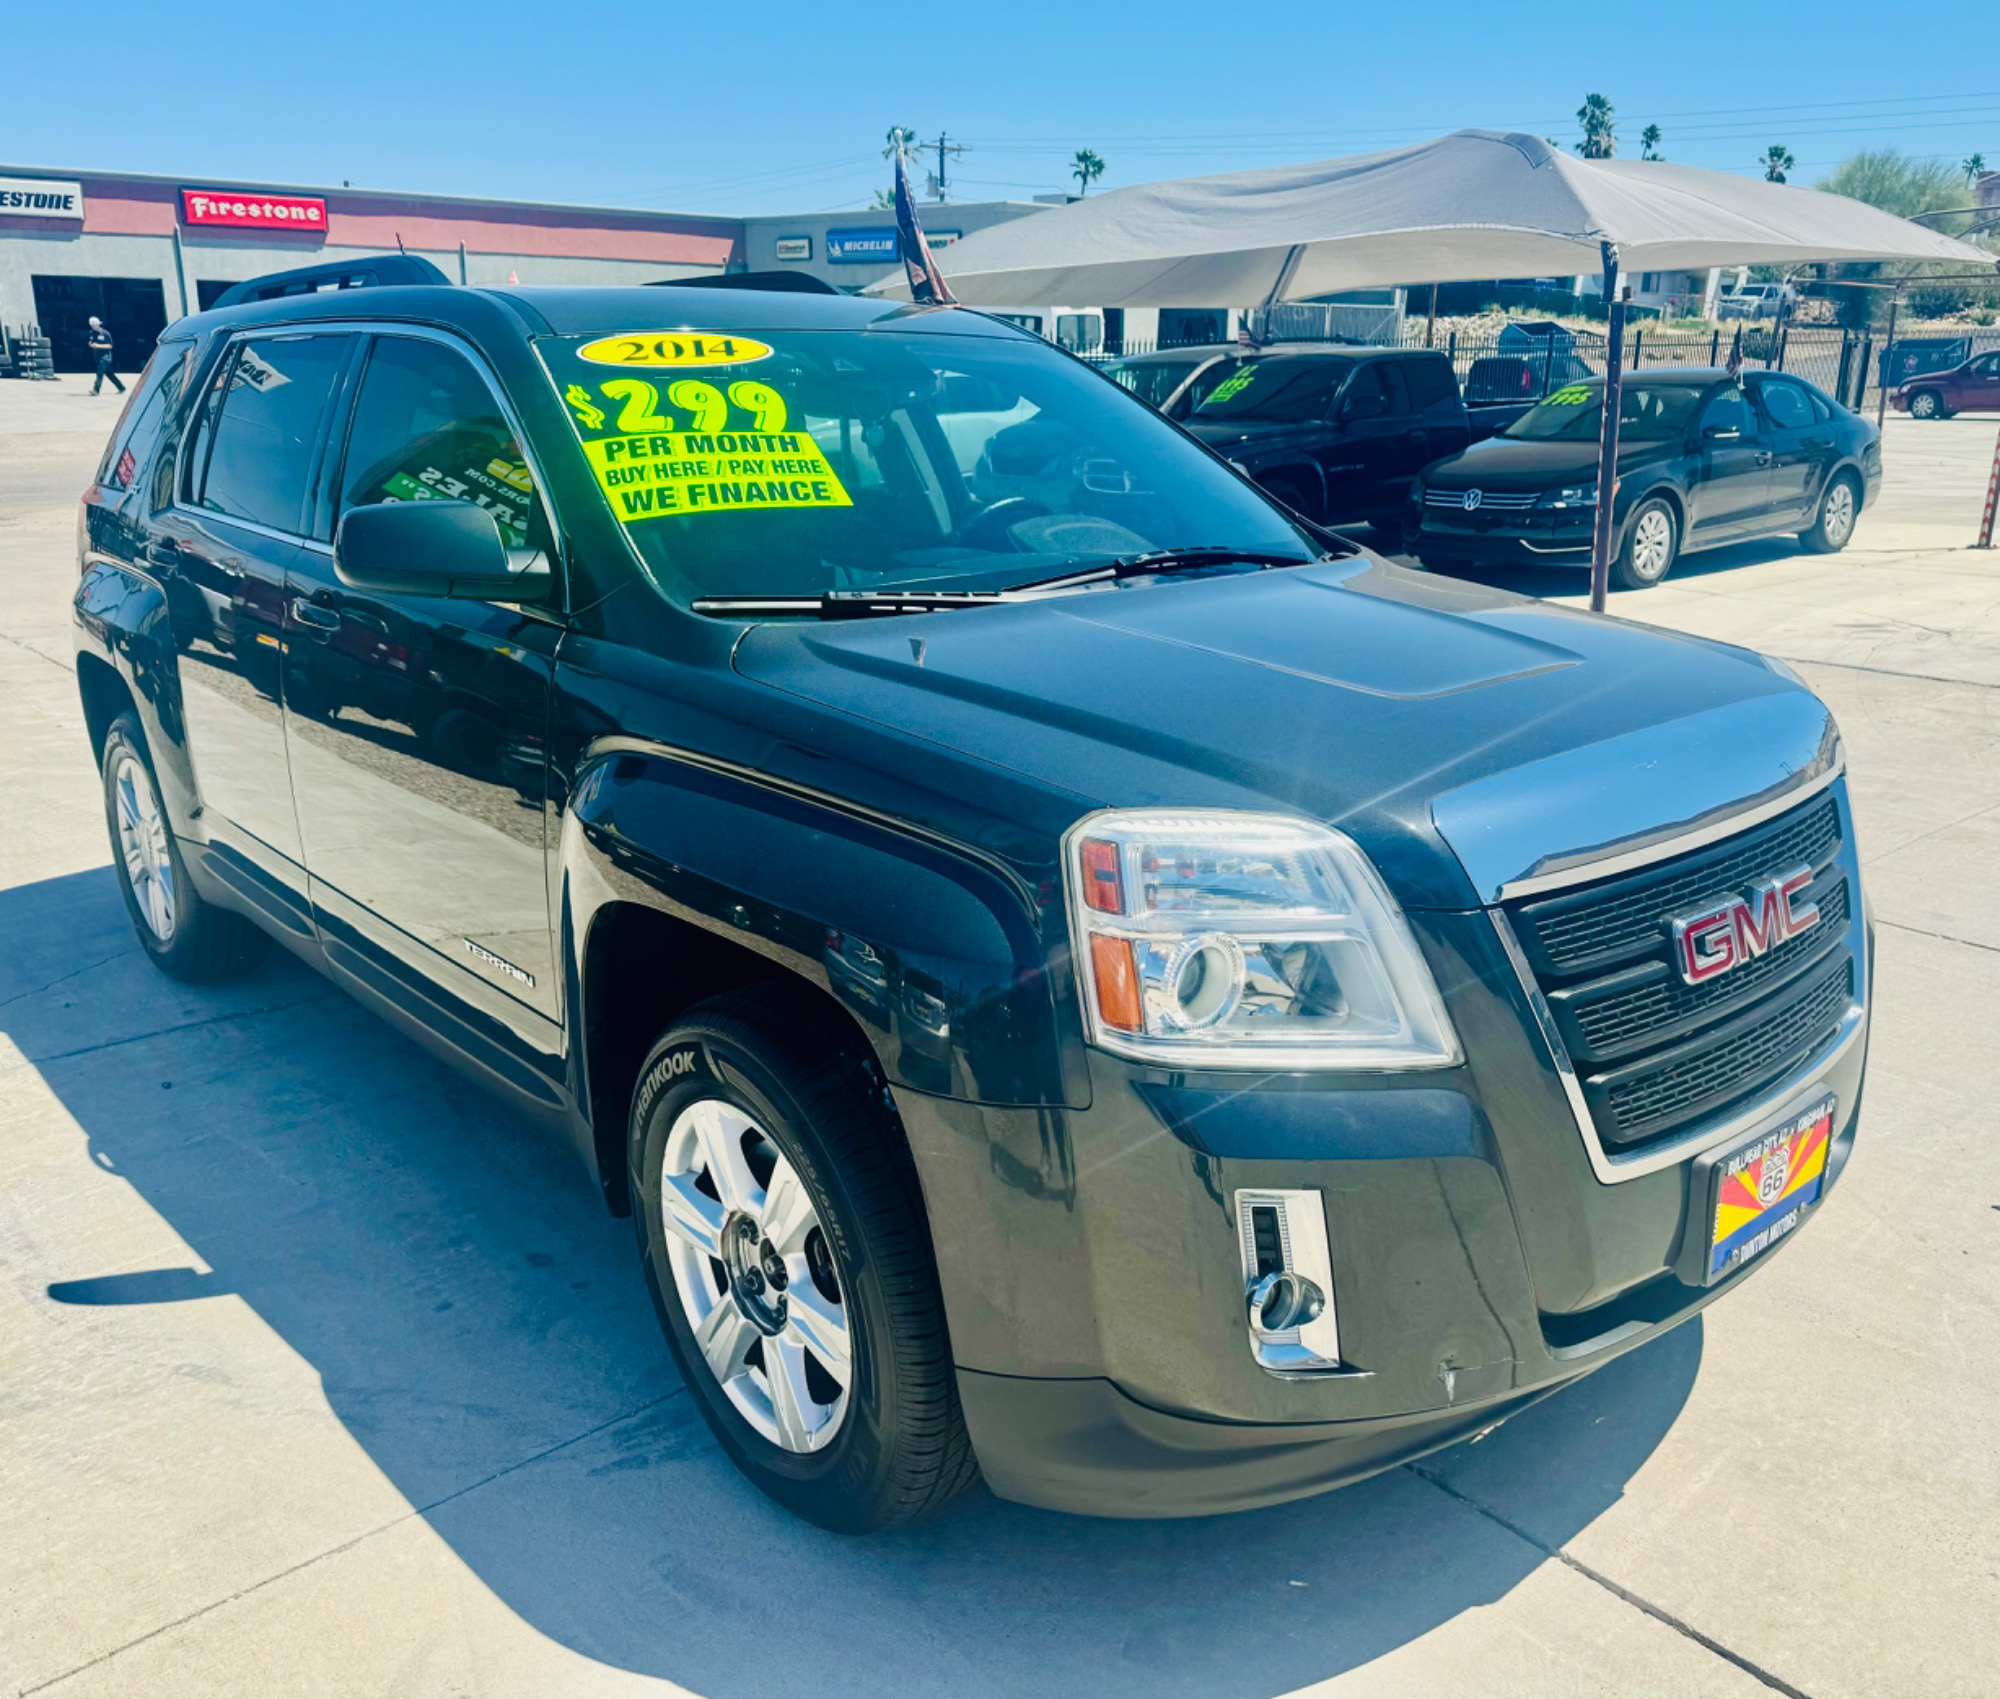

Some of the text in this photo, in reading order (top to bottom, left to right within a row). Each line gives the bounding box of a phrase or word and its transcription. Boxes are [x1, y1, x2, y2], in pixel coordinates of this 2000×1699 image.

[190, 196, 321, 221] Firestone
[843, 240, 894, 251] MICHELIN
[616, 338, 738, 361] 2014
[604, 434, 802, 463] PER MONTH
[605, 464, 648, 487] BUY
[653, 460, 708, 480] HERE
[728, 459, 769, 475] PAY
[770, 459, 824, 475] HERE
[620, 481, 833, 515] WE FINANCE
[1674, 864, 1820, 986] GMC
[1761, 1168, 1785, 1198] 66
